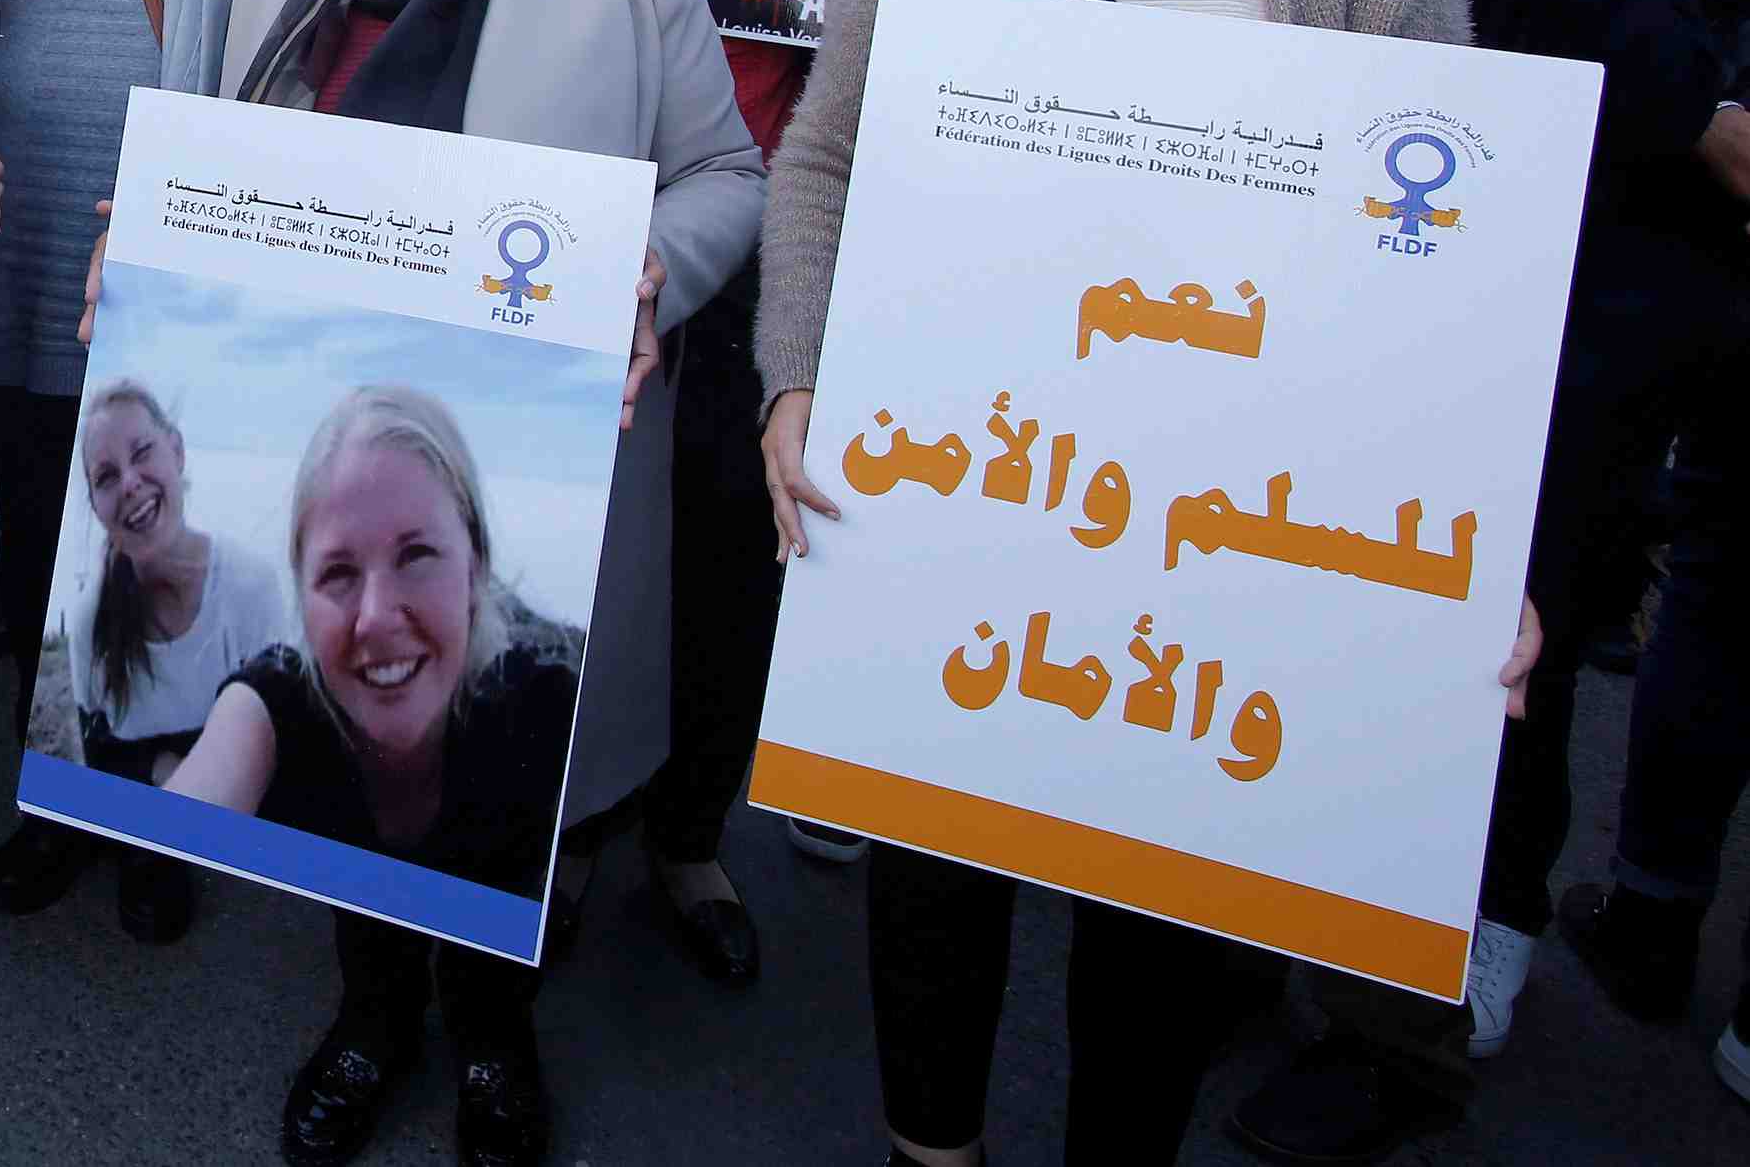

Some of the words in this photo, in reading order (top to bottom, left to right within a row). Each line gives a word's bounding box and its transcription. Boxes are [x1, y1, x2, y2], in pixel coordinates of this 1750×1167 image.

[936, 125, 1020, 150] Fédération
[1026, 141, 1051, 154] des
[1058, 145, 1111, 163] Ligues
[1116, 155, 1143, 169] des
[1149, 159, 1201, 178] Droits
[1206, 168, 1237, 184] Des
[1243, 174, 1315, 196] Femmes
[163, 216, 228, 236] Fédération
[232, 228, 252, 240] des
[256, 232, 296, 248] Ligues
[300, 240, 320, 252] des
[324, 244, 362, 260] Droits
[367, 251, 389, 265] Des
[393, 256, 447, 274] Femmes
[1378, 232, 1437, 257] FLDF
[492, 305, 534, 326] FLDF
[1077, 278, 1265, 360] نعم
[842, 391, 1131, 549] والأمن
[1164, 471, 1477, 601] للسلم
[942, 612, 1282, 782] والأمان
